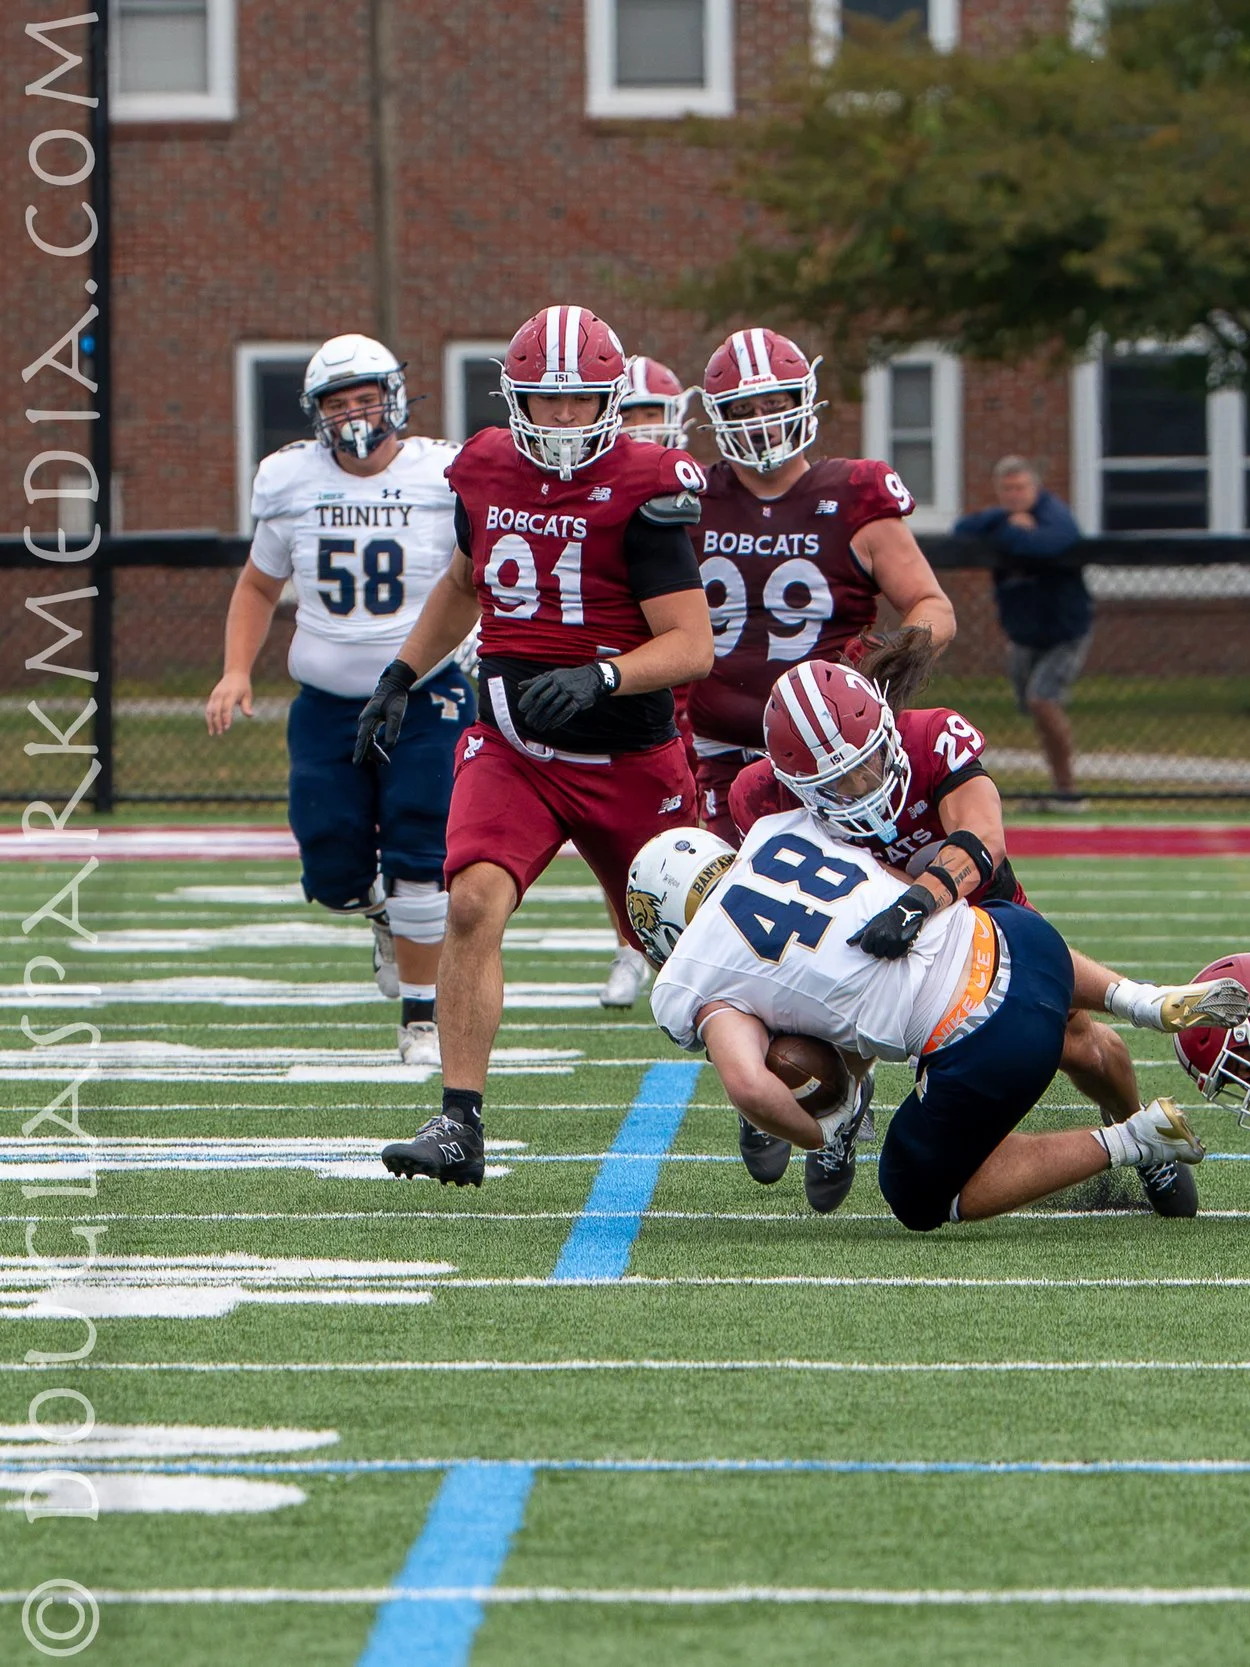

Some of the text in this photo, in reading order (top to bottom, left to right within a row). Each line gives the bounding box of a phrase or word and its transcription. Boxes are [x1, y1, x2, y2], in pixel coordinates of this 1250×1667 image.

[315, 504, 413, 527] TRINITY
[486, 505, 588, 539] BOBCATS
[703, 530, 820, 556] BOBCATS
[317, 537, 406, 617] 58
[484, 533, 585, 626] 91
[698, 556, 834, 661] 99
[933, 714, 983, 773] 29
[719, 832, 871, 966] 48
[931, 994, 979, 1046] NIKE
